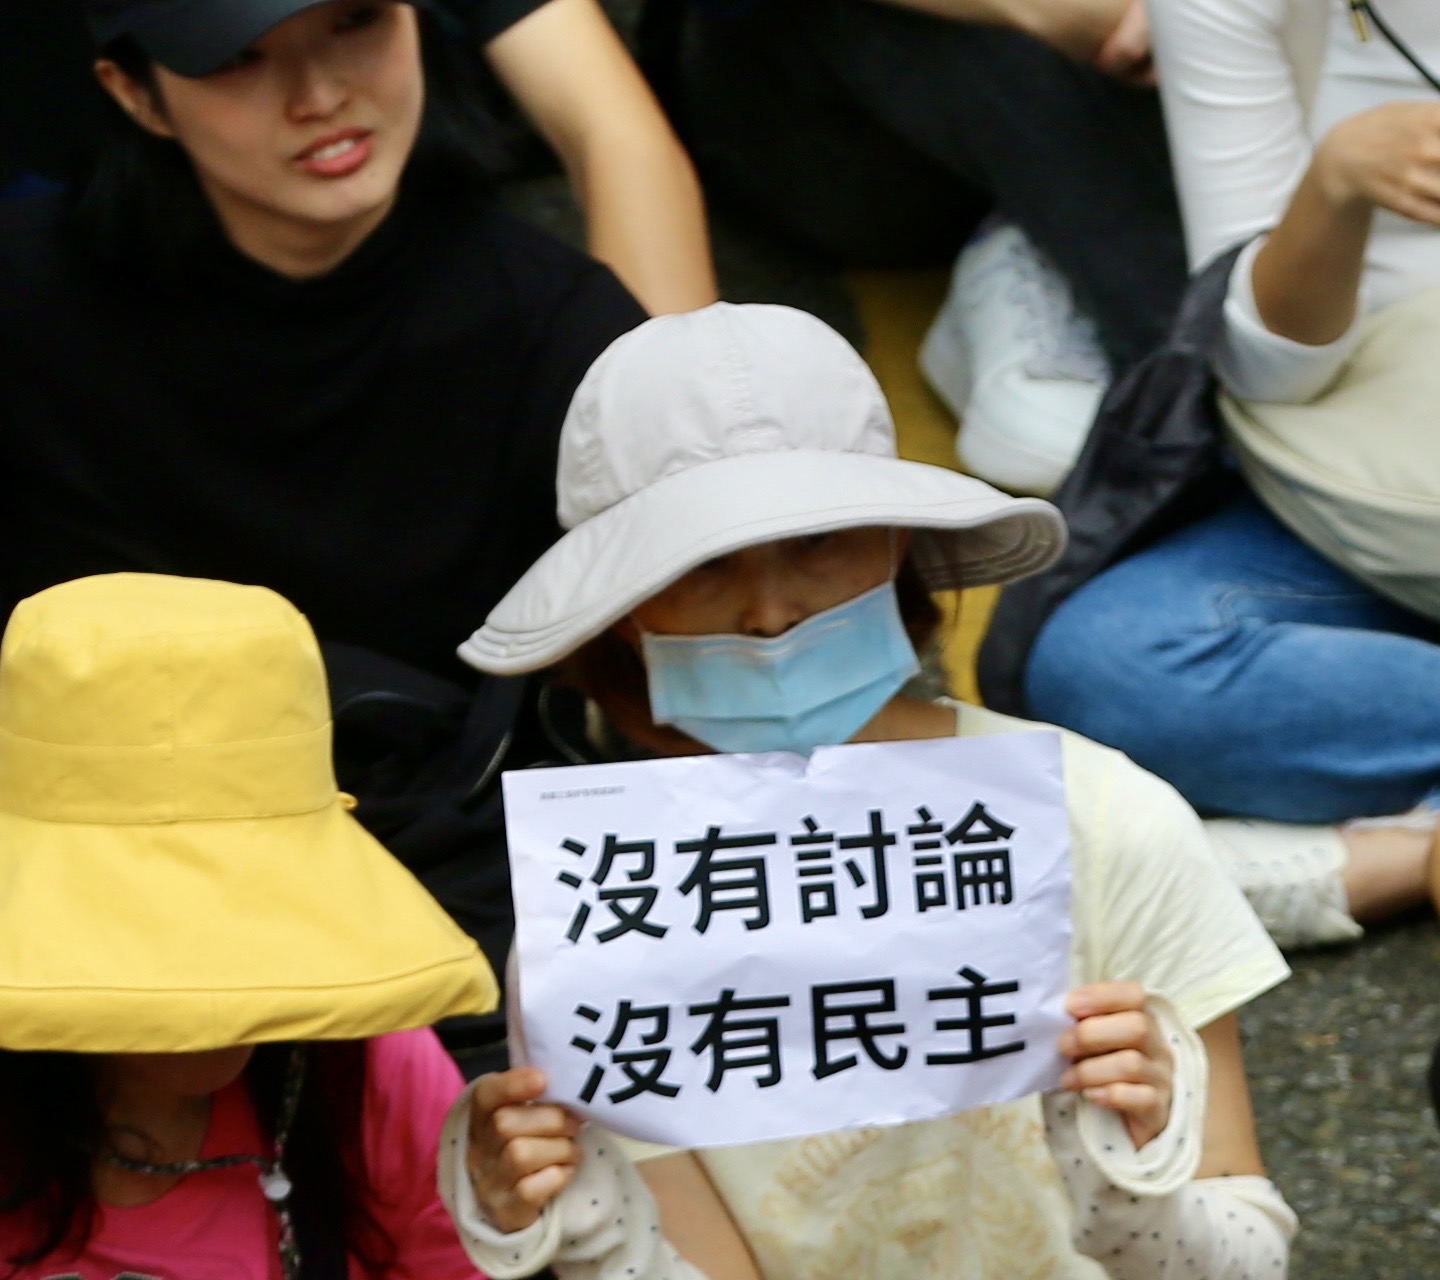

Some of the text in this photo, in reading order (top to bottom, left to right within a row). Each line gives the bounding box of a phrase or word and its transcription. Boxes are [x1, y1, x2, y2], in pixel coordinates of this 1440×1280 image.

[555, 801, 1016, 945] 沒有討論
[569, 966, 1026, 1105] 沒有民主
